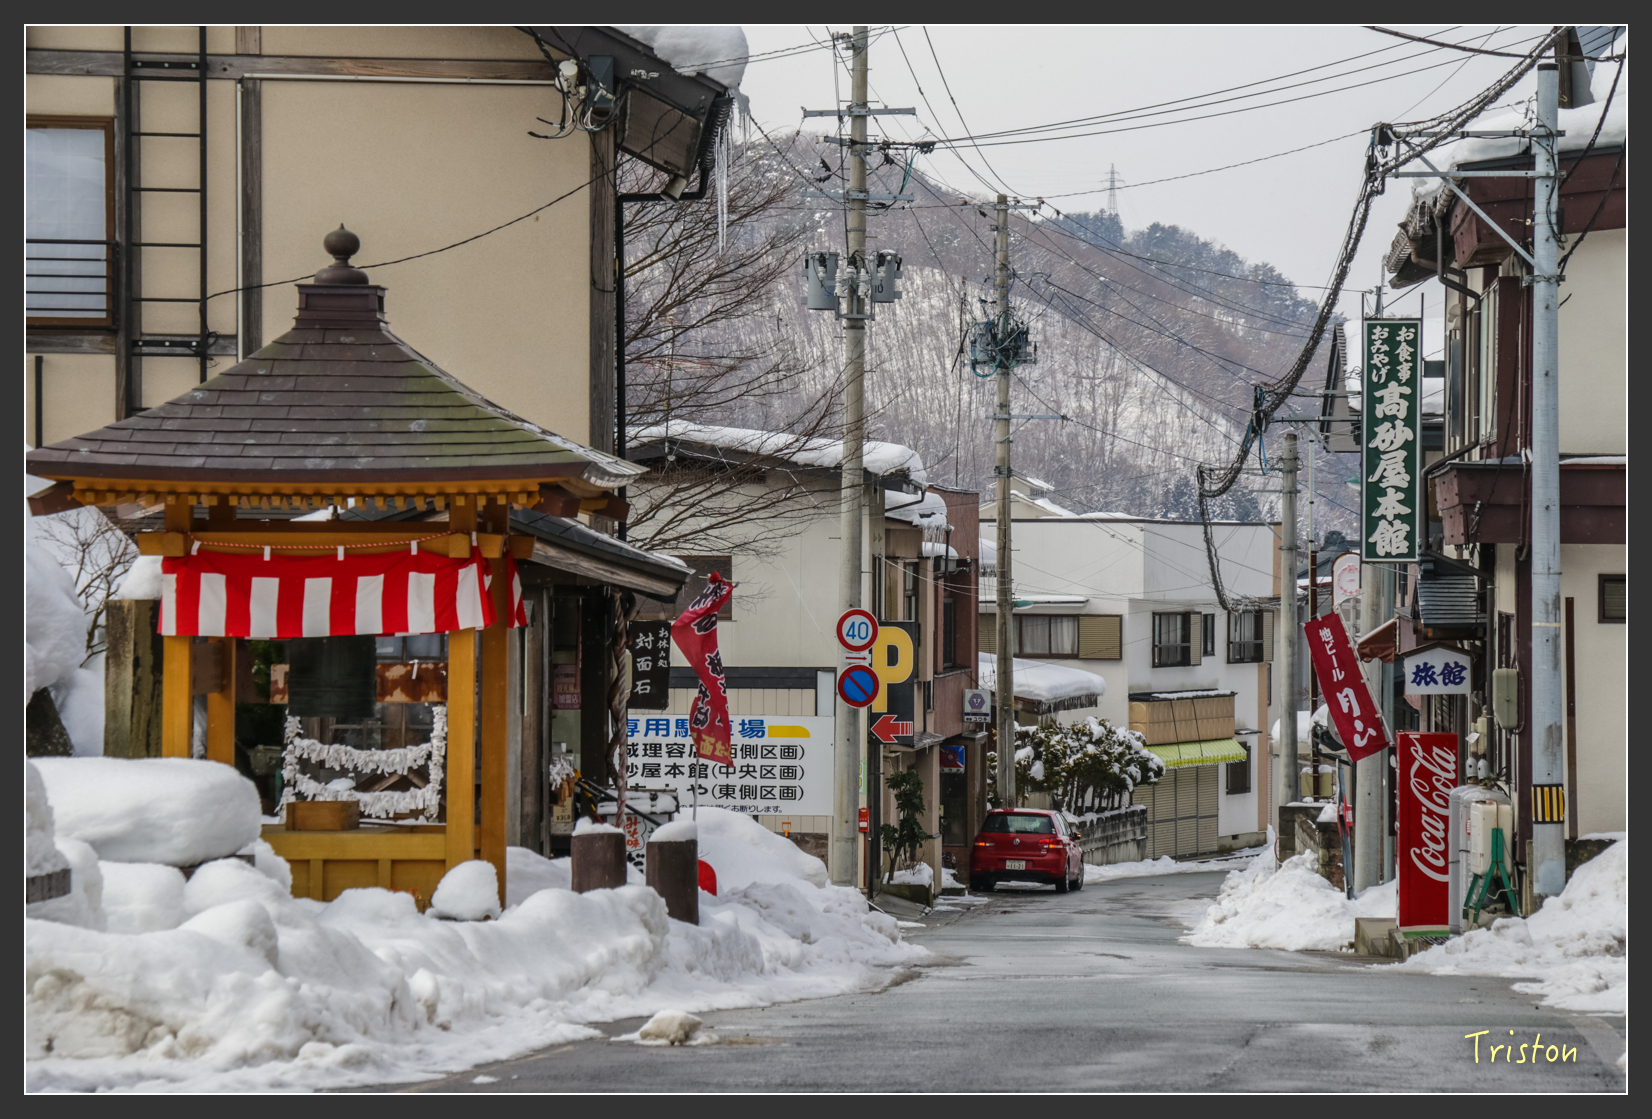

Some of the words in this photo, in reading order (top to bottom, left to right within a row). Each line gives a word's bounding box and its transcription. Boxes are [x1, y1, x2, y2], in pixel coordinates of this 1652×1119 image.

[1370, 325, 1391, 384] おみやげ
[1394, 326, 1416, 384] お食事
[656, 627, 669, 668] お休み処
[846, 621, 869, 640] 40
[1319, 627, 1345, 682] 地ビール
[633, 632, 655, 695] 対面石
[871, 626, 914, 713] P
[1410, 660, 1468, 687] 旅館
[1410, 734, 1457, 882] Coca-Cola
